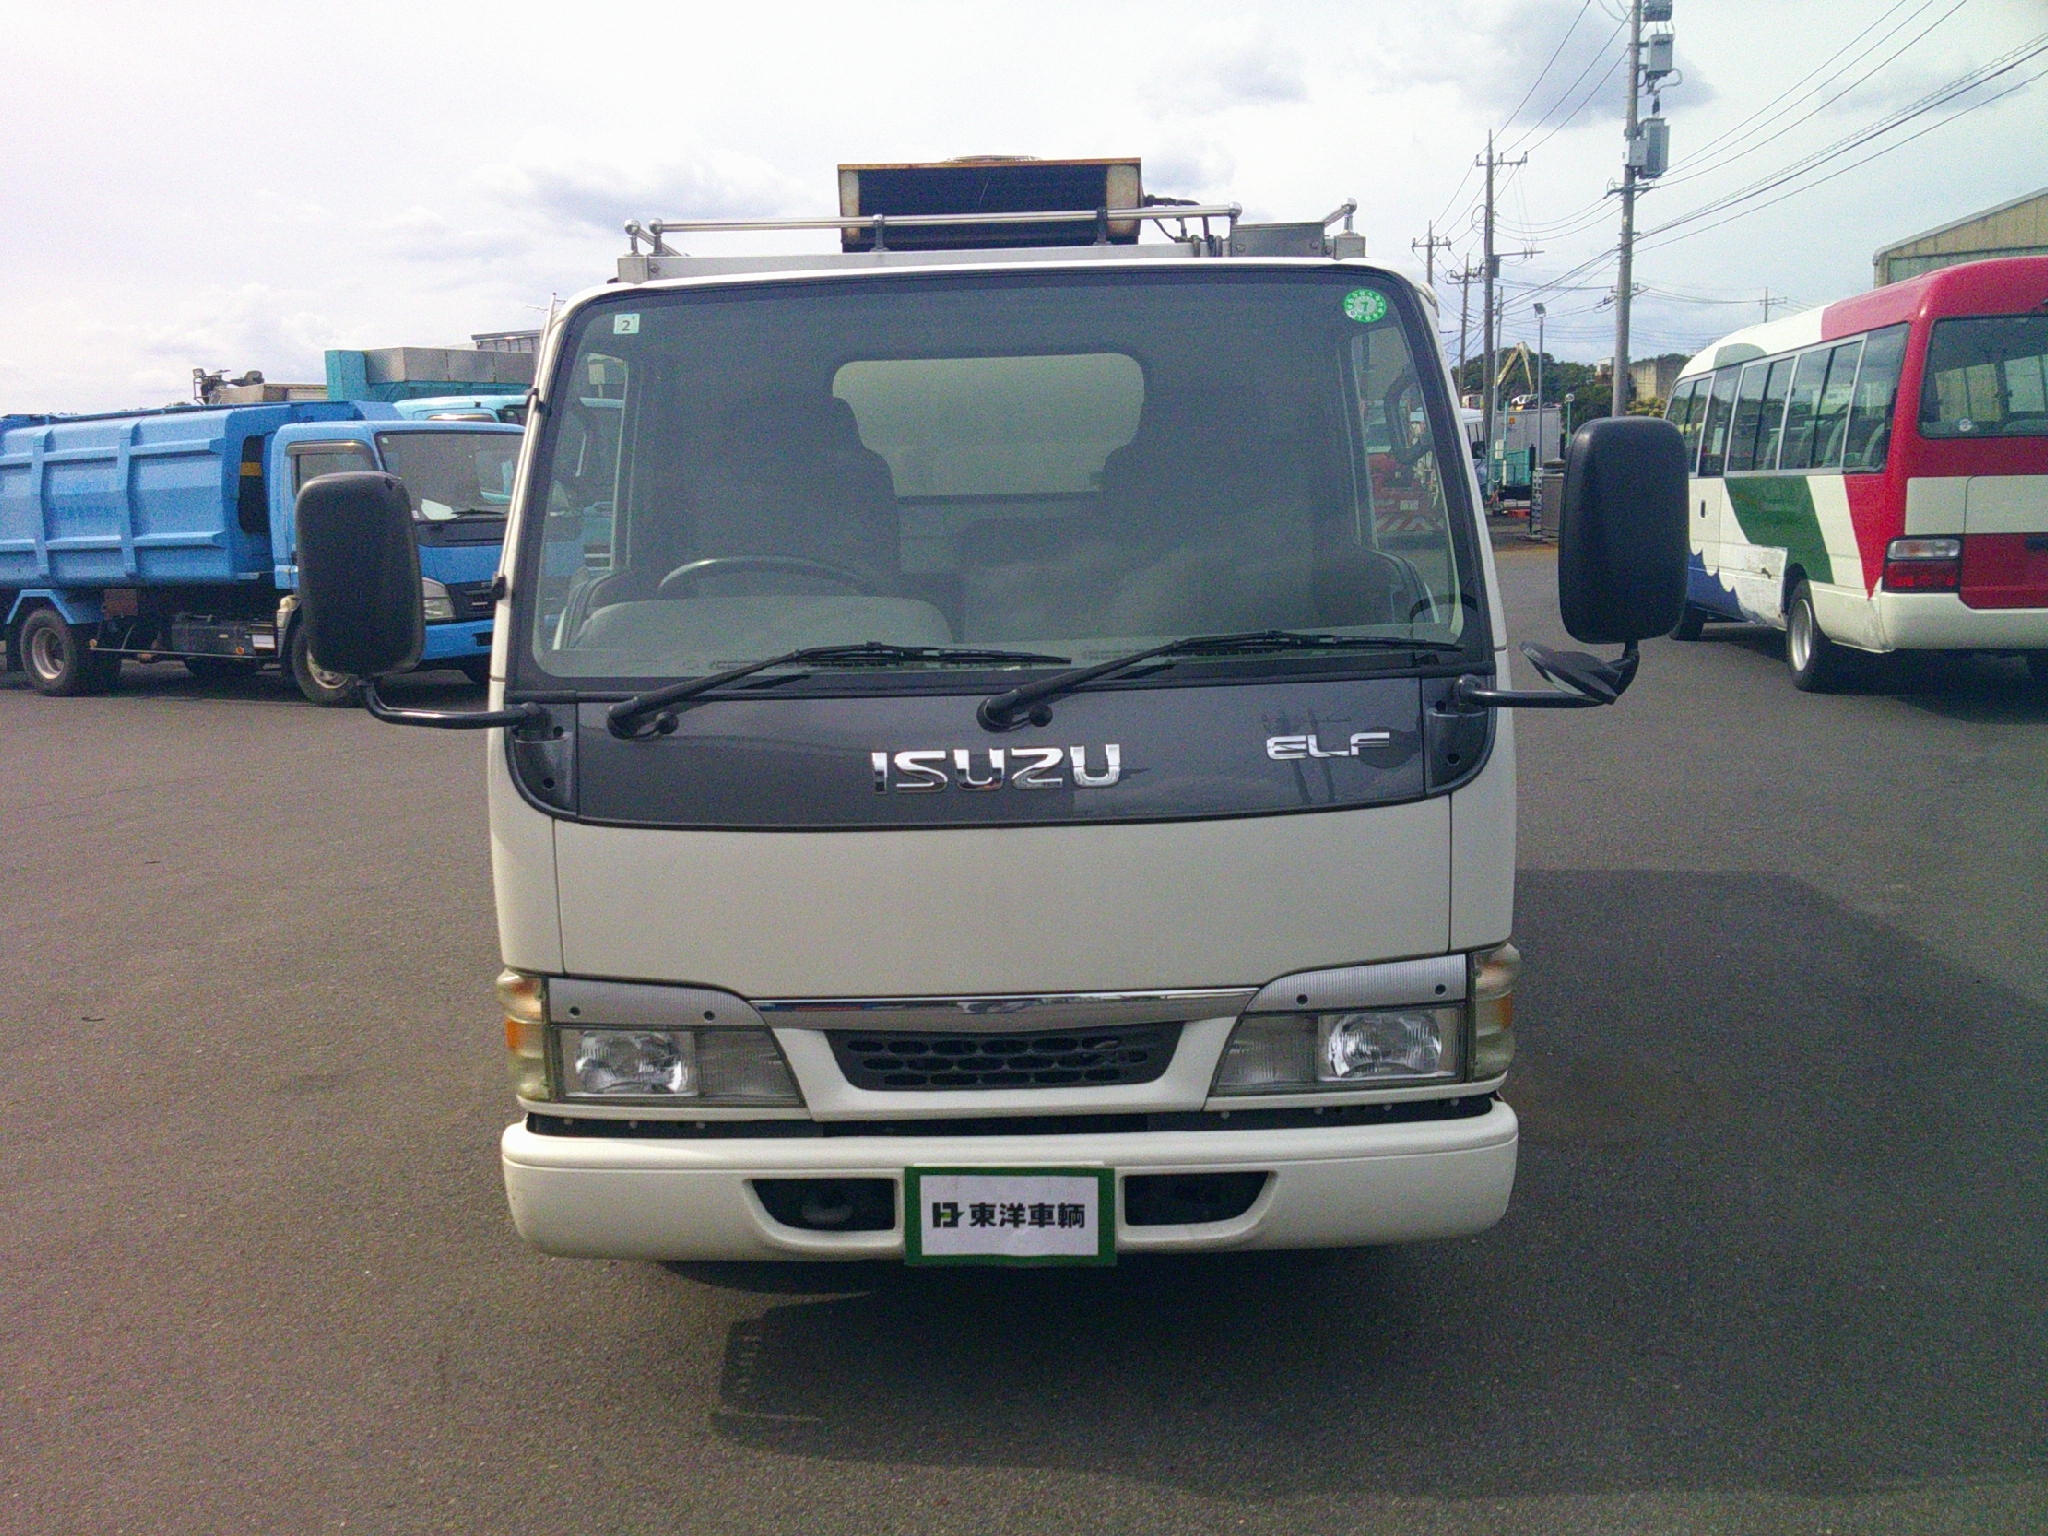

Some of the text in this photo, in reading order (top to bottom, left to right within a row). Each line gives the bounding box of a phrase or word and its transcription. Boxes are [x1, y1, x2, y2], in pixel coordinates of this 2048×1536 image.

[621, 319, 631, 331] 2
[1266, 732, 1389, 761] ELF
[872, 744, 1120, 794] ISUZU
